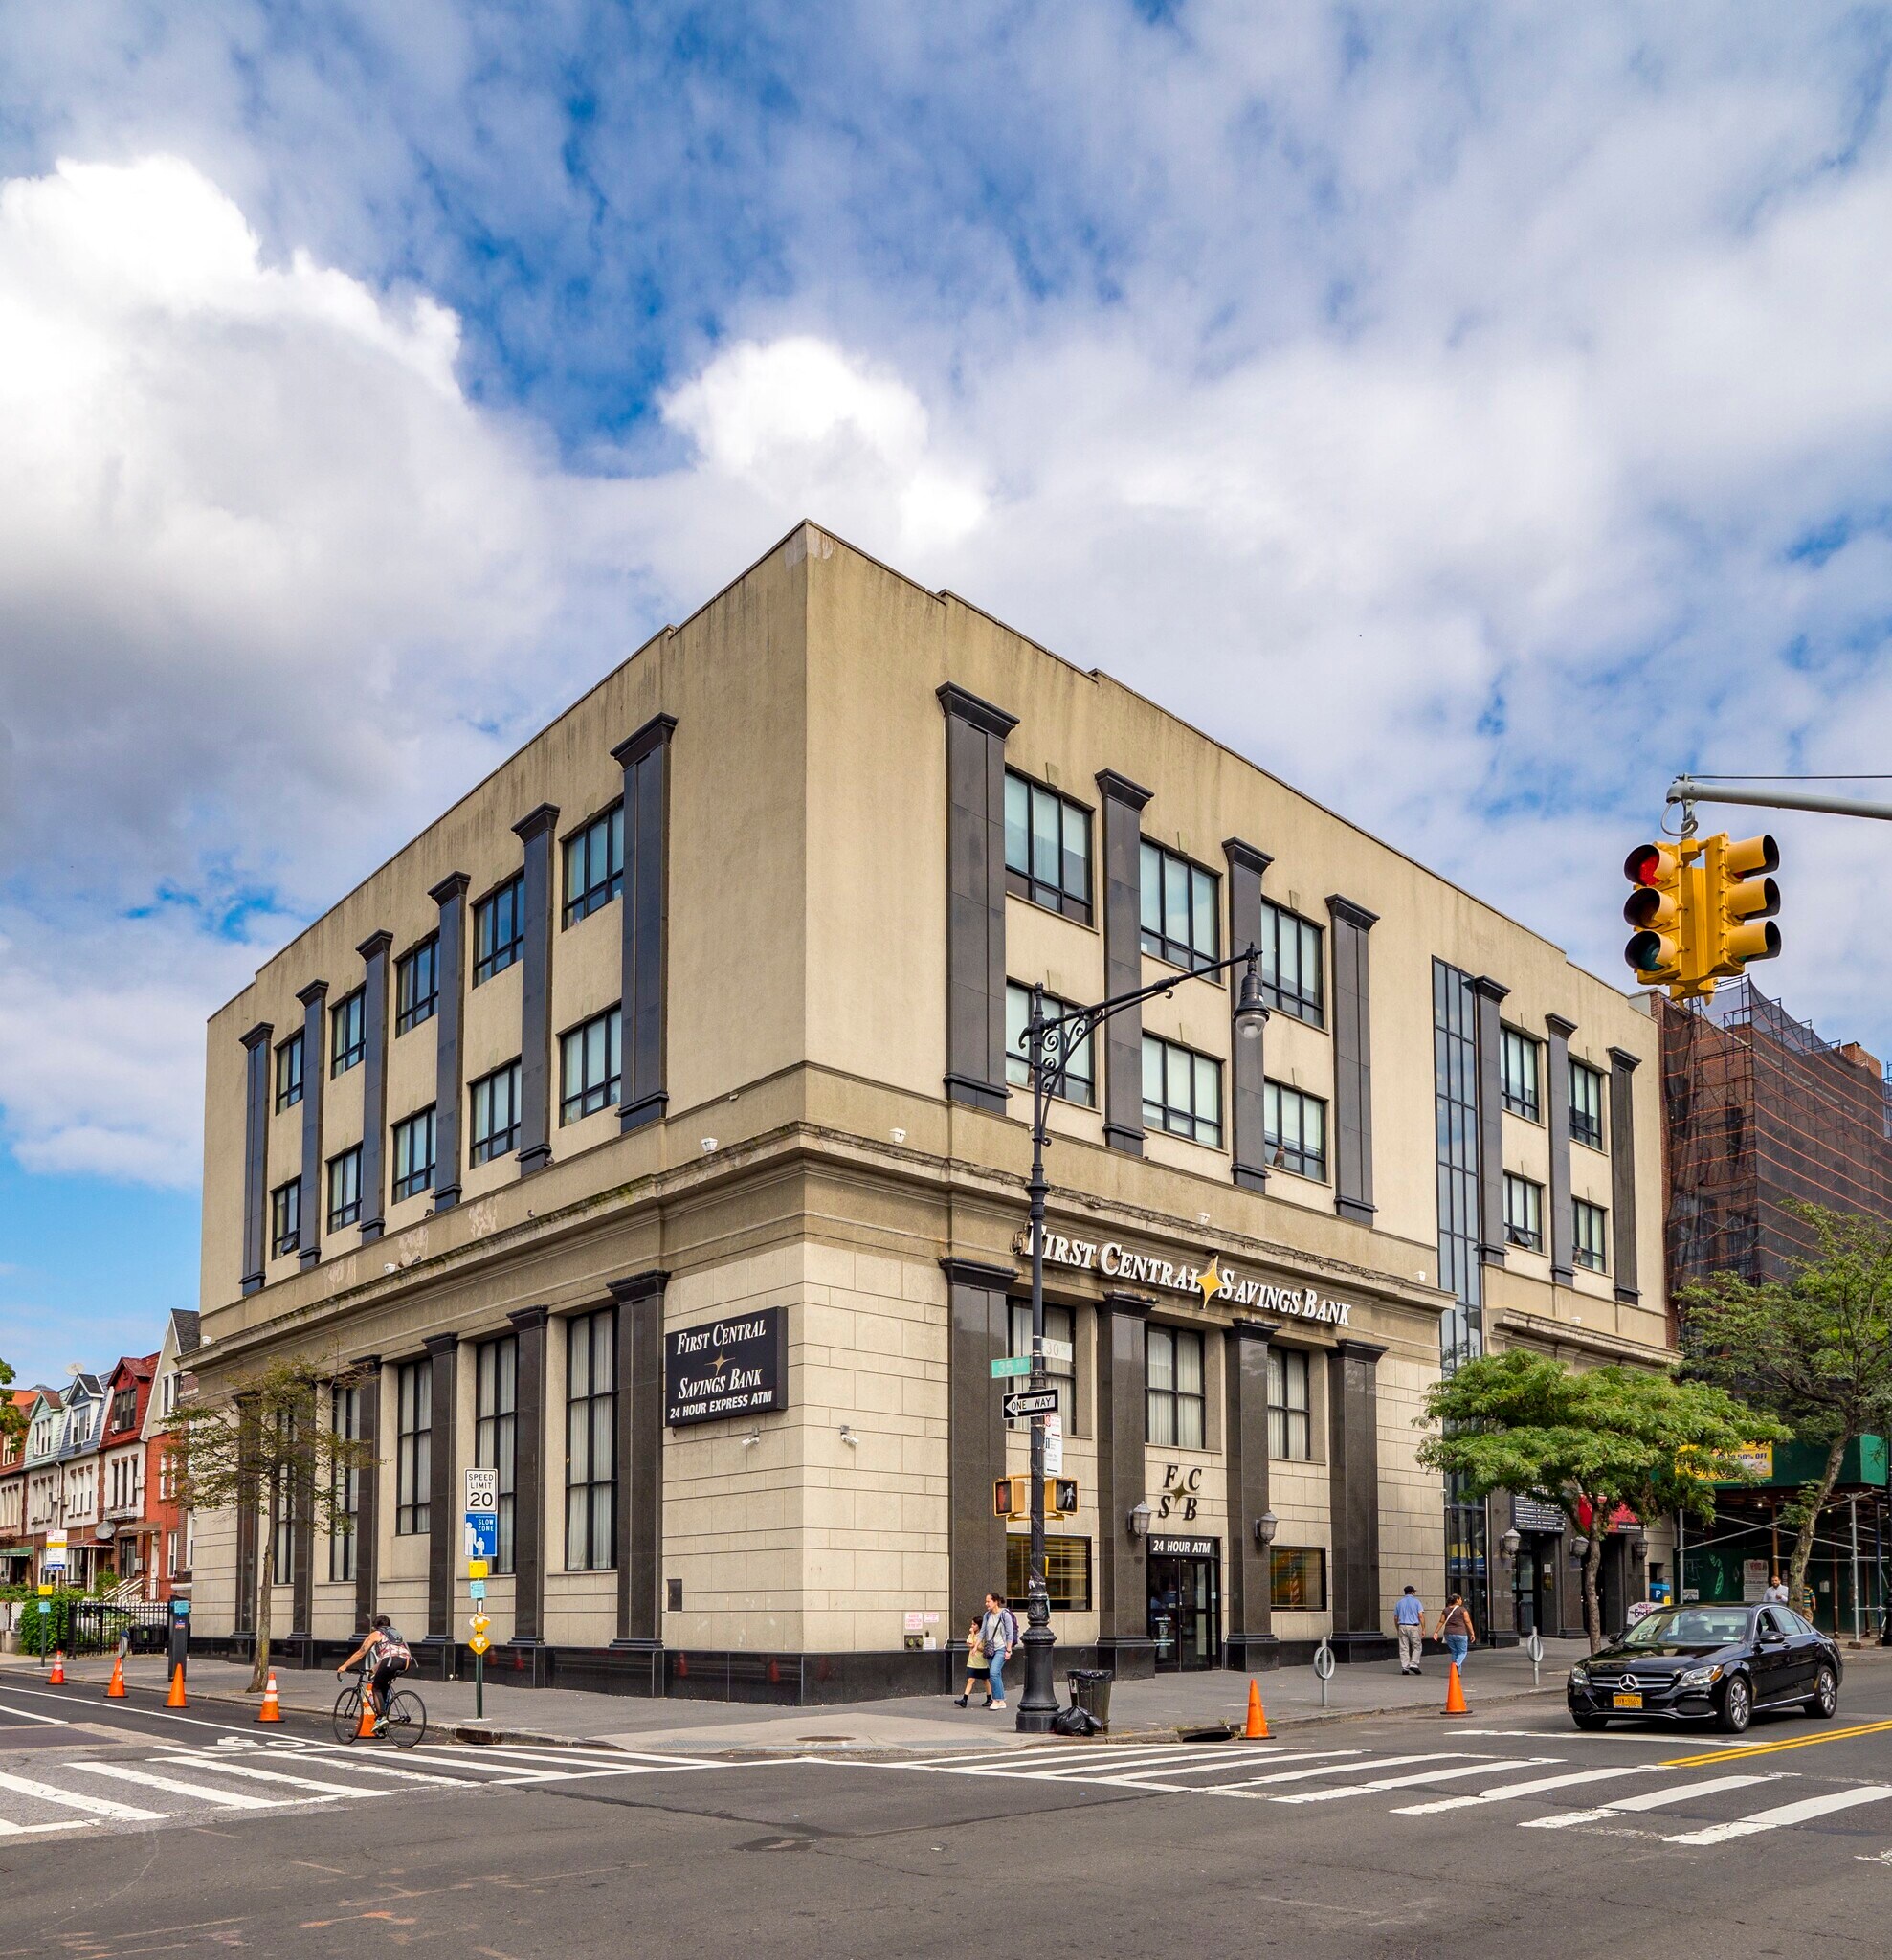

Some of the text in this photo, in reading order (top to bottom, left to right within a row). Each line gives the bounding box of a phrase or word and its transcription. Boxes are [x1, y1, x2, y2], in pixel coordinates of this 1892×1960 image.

[1100, 1242, 1202, 1294] CENTRAL
[1218, 1268, 1302, 1316] SAVINGS
[1302, 1288, 1352, 1326] BANK
[676, 1319, 767, 1355] FIRST CENTRAL
[1046, 1342, 1059, 1357] 30
[998, 1361, 1013, 1375] 35
[678, 1368, 763, 1400] SAVINGS BANK
[669, 1391, 773, 1419] 24 HOUR EXPRESS ATM
[1011, 1396, 1052, 1411] ONE WAY
[1163, 1464, 1202, 1491] F C
[470, 1491, 493, 1507] 20
[1158, 1495, 1198, 1521] S B
[1153, 1540, 1212, 1554] 24 HOUR ATM
[1655, 1589, 1661, 1598] P
